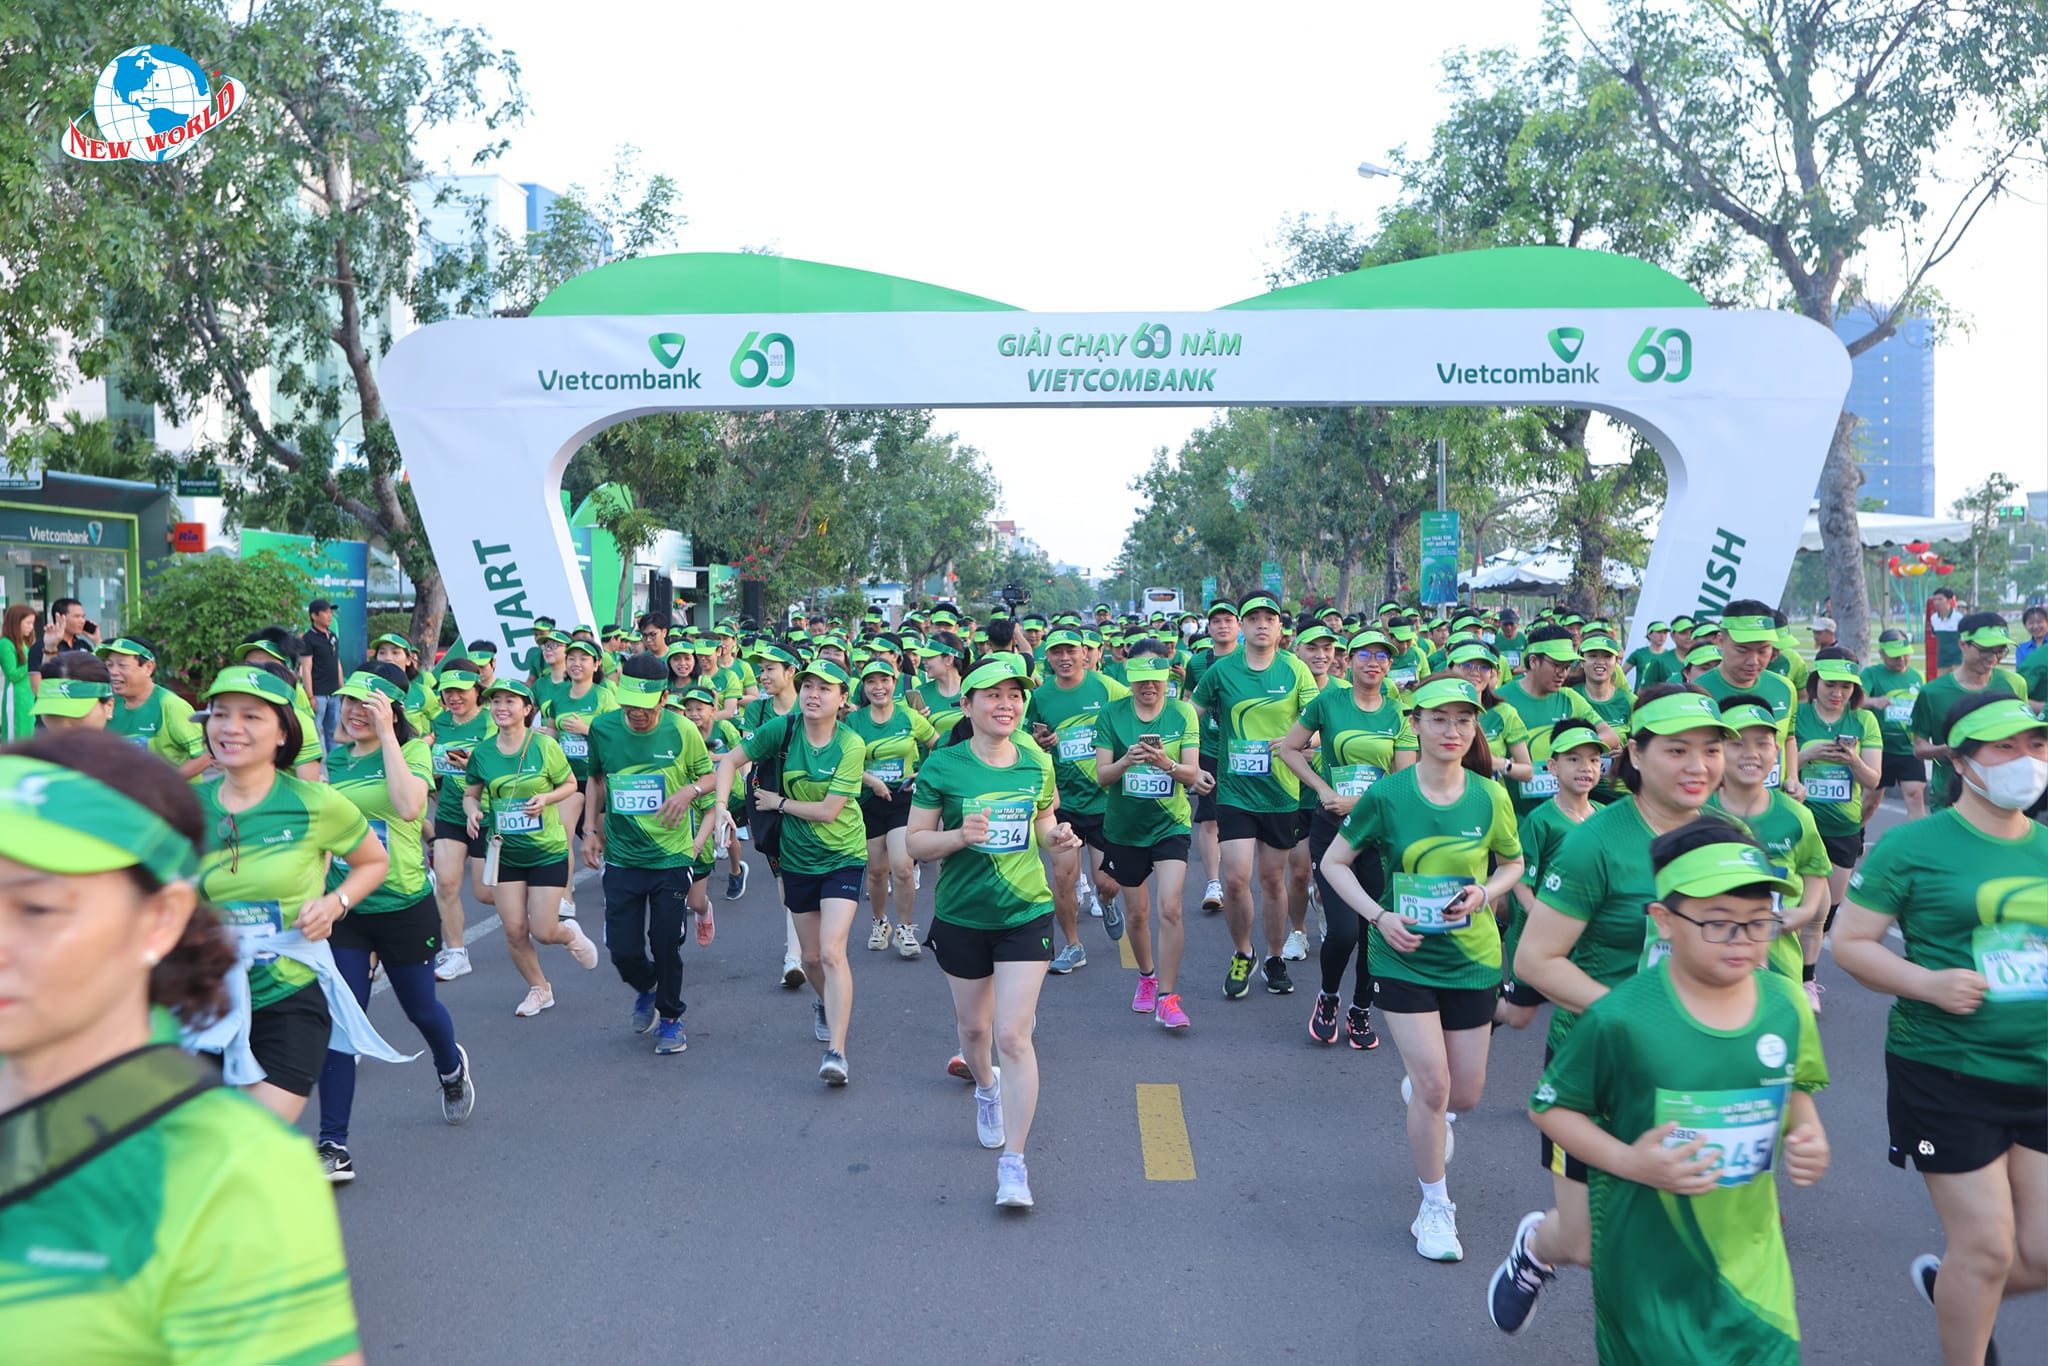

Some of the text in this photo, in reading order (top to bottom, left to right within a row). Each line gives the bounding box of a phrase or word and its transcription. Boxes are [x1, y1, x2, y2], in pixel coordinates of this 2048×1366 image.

[997, 322, 1241, 362] GIẢI CHẠY 60 NĂM
[730, 331, 795, 388] 60
[1628, 326, 1692, 383] 60
[537, 368, 702, 390] Vietcombank
[1028, 368, 1218, 392] VIETCOMBANK
[1437, 363, 1600, 384] Vietcombank
[29, 526, 89, 544] Vietcombank
[1692, 527, 1746, 622] NISH
[565, 745, 585, 754] 309
[1232, 759, 1263, 771] 0321
[1130, 779, 1168, 793] 0350
[1343, 786, 1365, 796] 013
[1808, 784, 1844, 797] 0310
[616, 796, 657, 809] 0376
[985, 828, 1022, 846] 234
